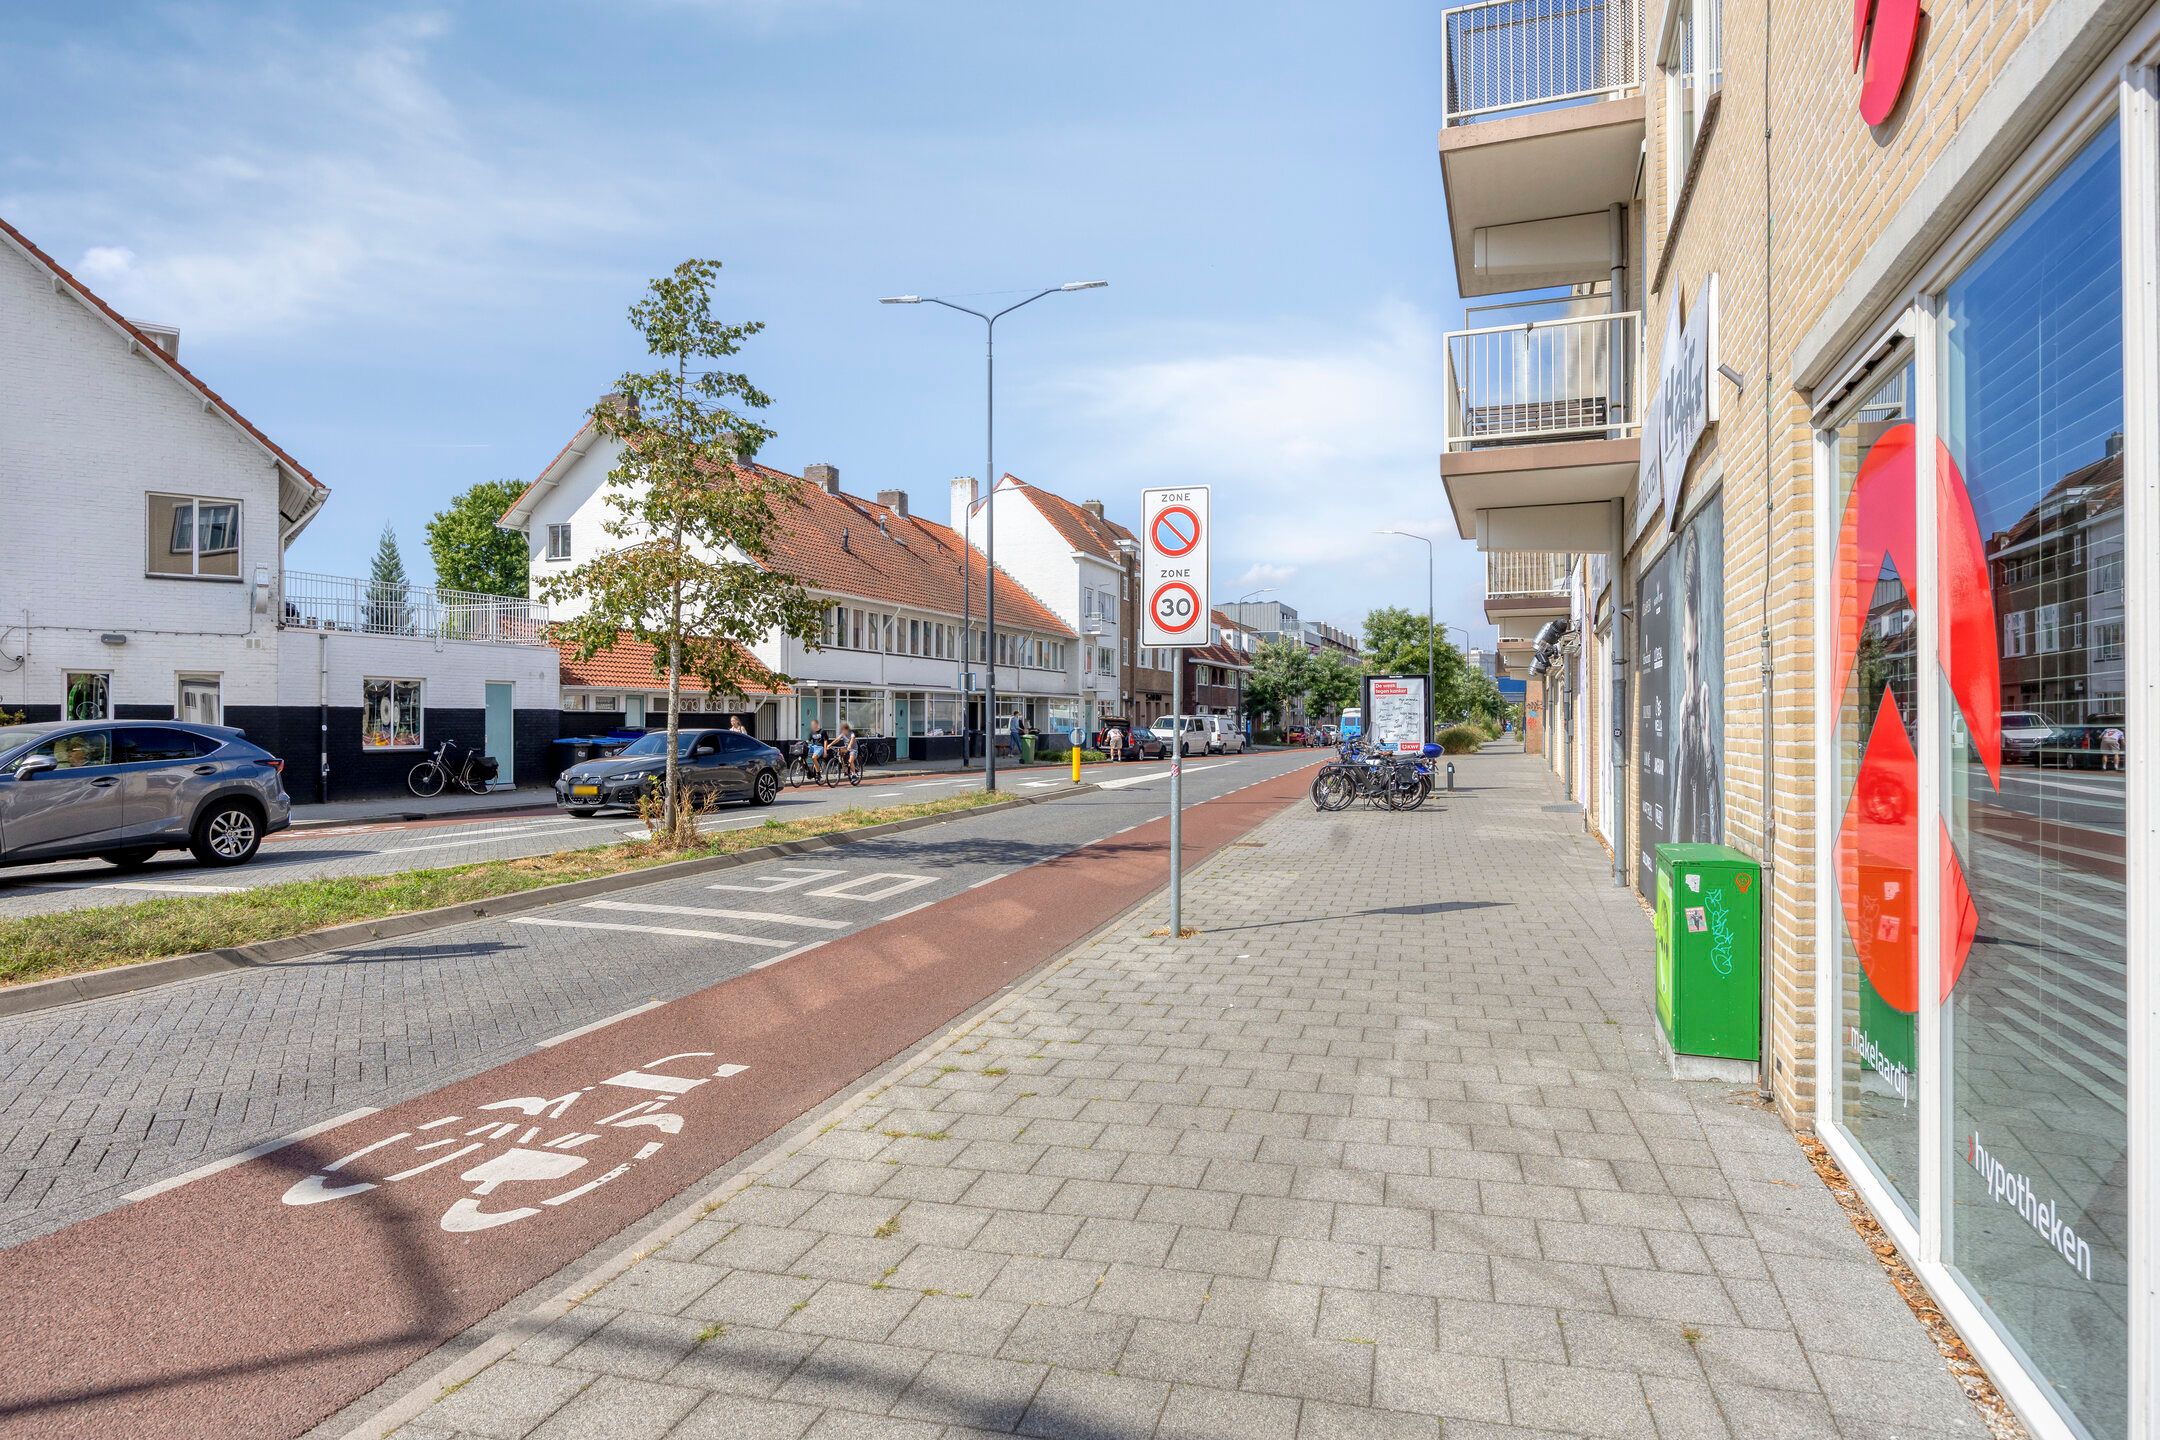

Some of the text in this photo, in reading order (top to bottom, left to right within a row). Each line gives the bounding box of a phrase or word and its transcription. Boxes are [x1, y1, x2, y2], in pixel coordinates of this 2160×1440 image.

[1161, 493, 1191, 502] ZONE
[1160, 569, 1190, 578] ZONE
[1160, 598, 1191, 617] 30
[704, 867, 942, 902] 30
[1851, 1026, 1908, 1108] makelaardij
[1975, 1131, 2092, 1281] hypotheken
